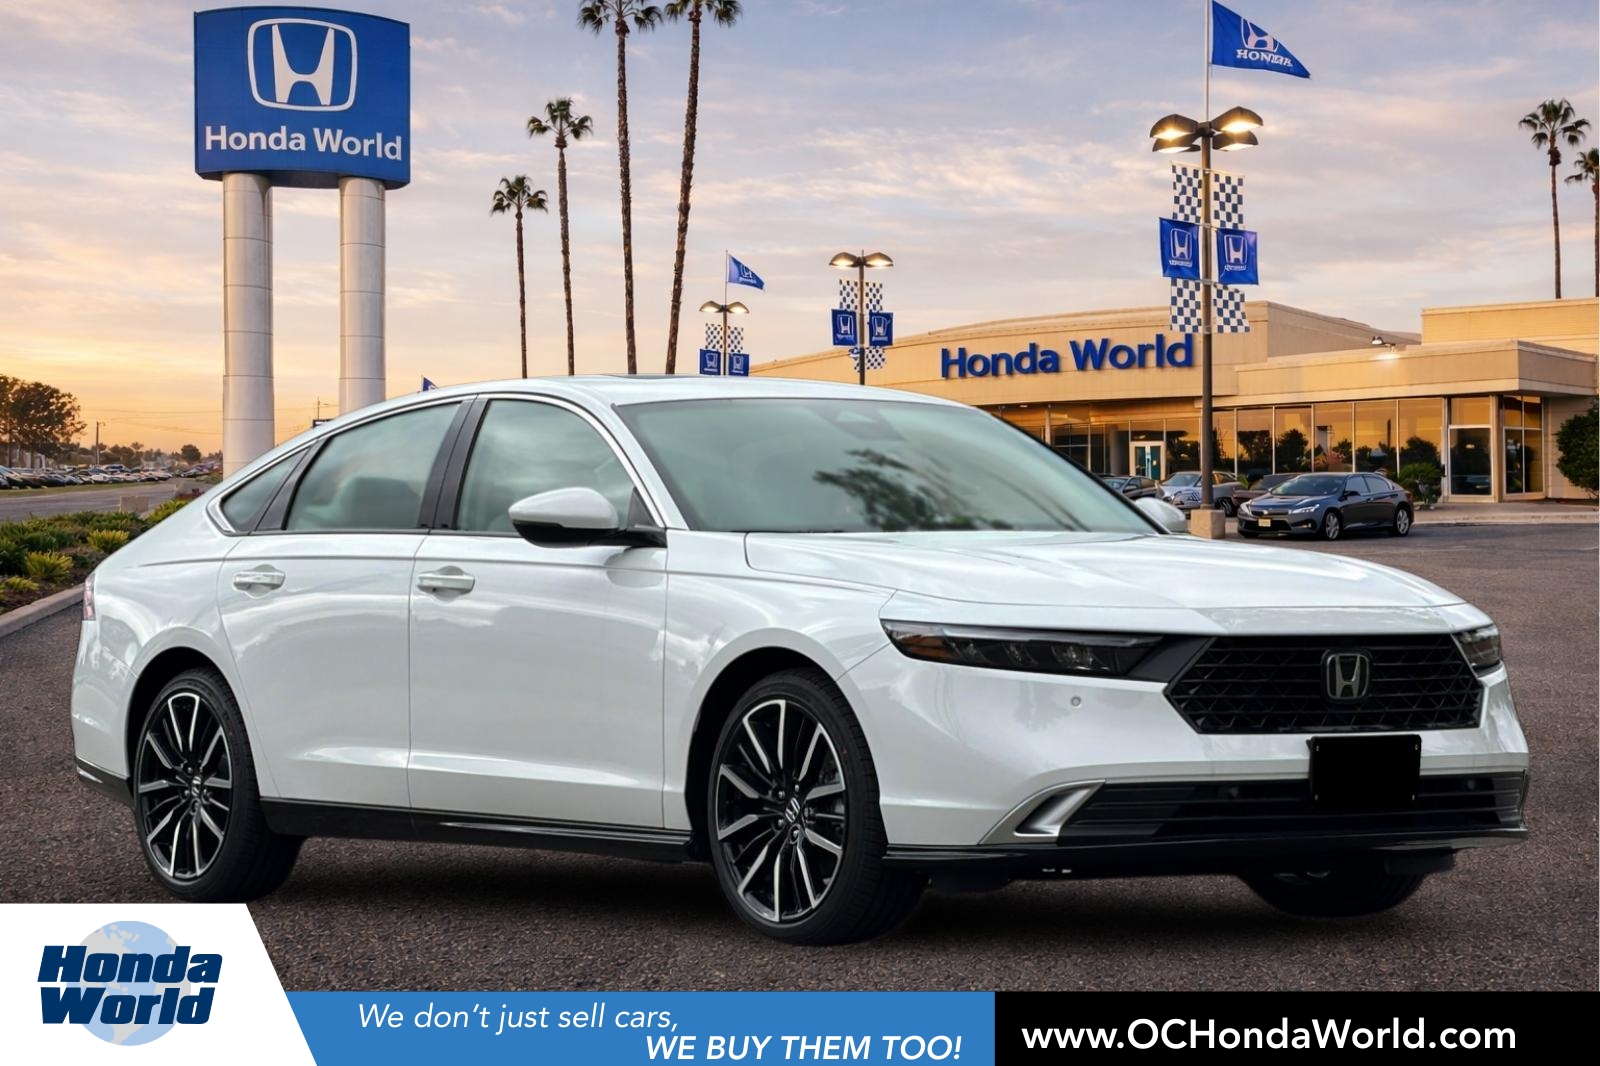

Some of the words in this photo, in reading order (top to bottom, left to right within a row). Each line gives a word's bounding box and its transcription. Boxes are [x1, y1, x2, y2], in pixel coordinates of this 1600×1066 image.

[205, 125, 306, 151] Honda
[312, 127, 402, 161] World
[941, 342, 1061, 379] Honda
[1069, 333, 1194, 371] World
